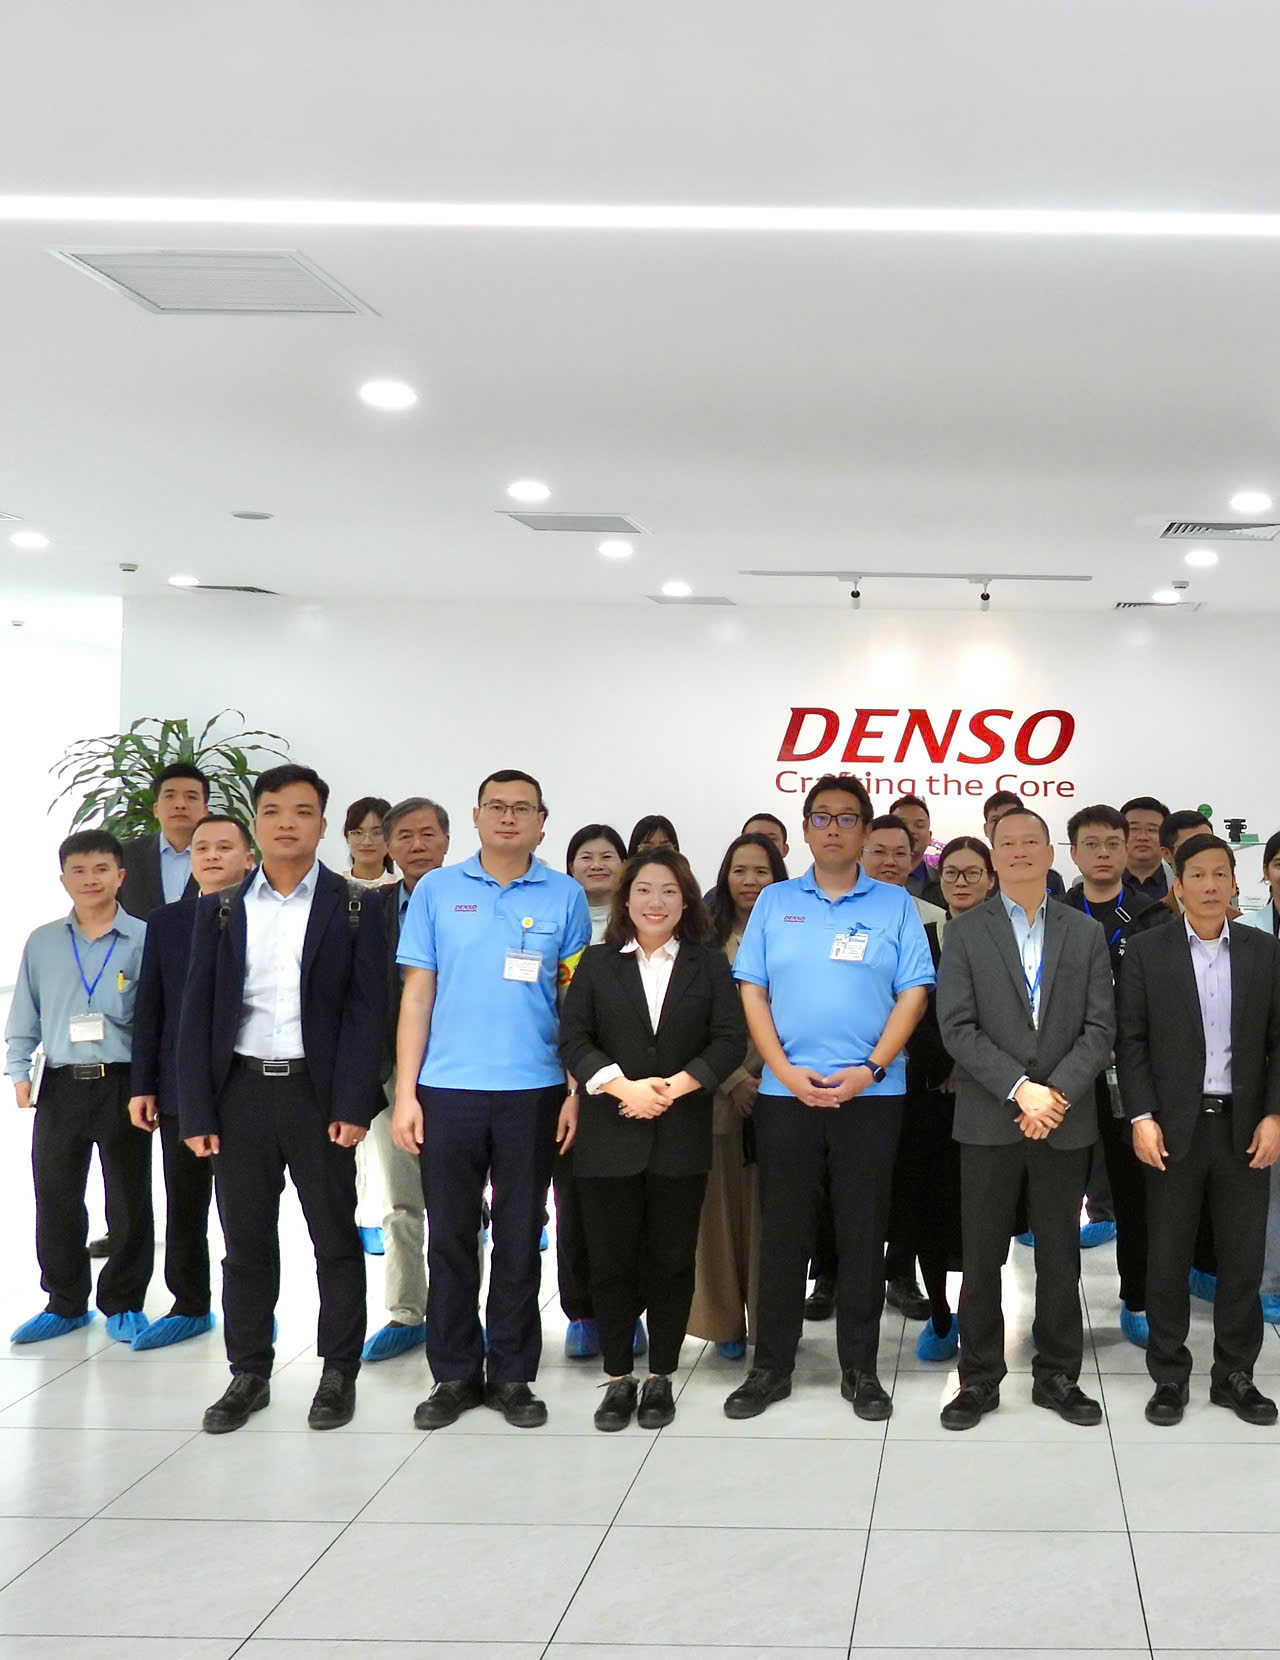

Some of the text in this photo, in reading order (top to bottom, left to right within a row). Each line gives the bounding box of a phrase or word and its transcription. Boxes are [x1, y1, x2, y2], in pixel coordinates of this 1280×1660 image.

[776, 707, 1075, 766] DENSO
[775, 770, 1075, 798] Cring the Core
